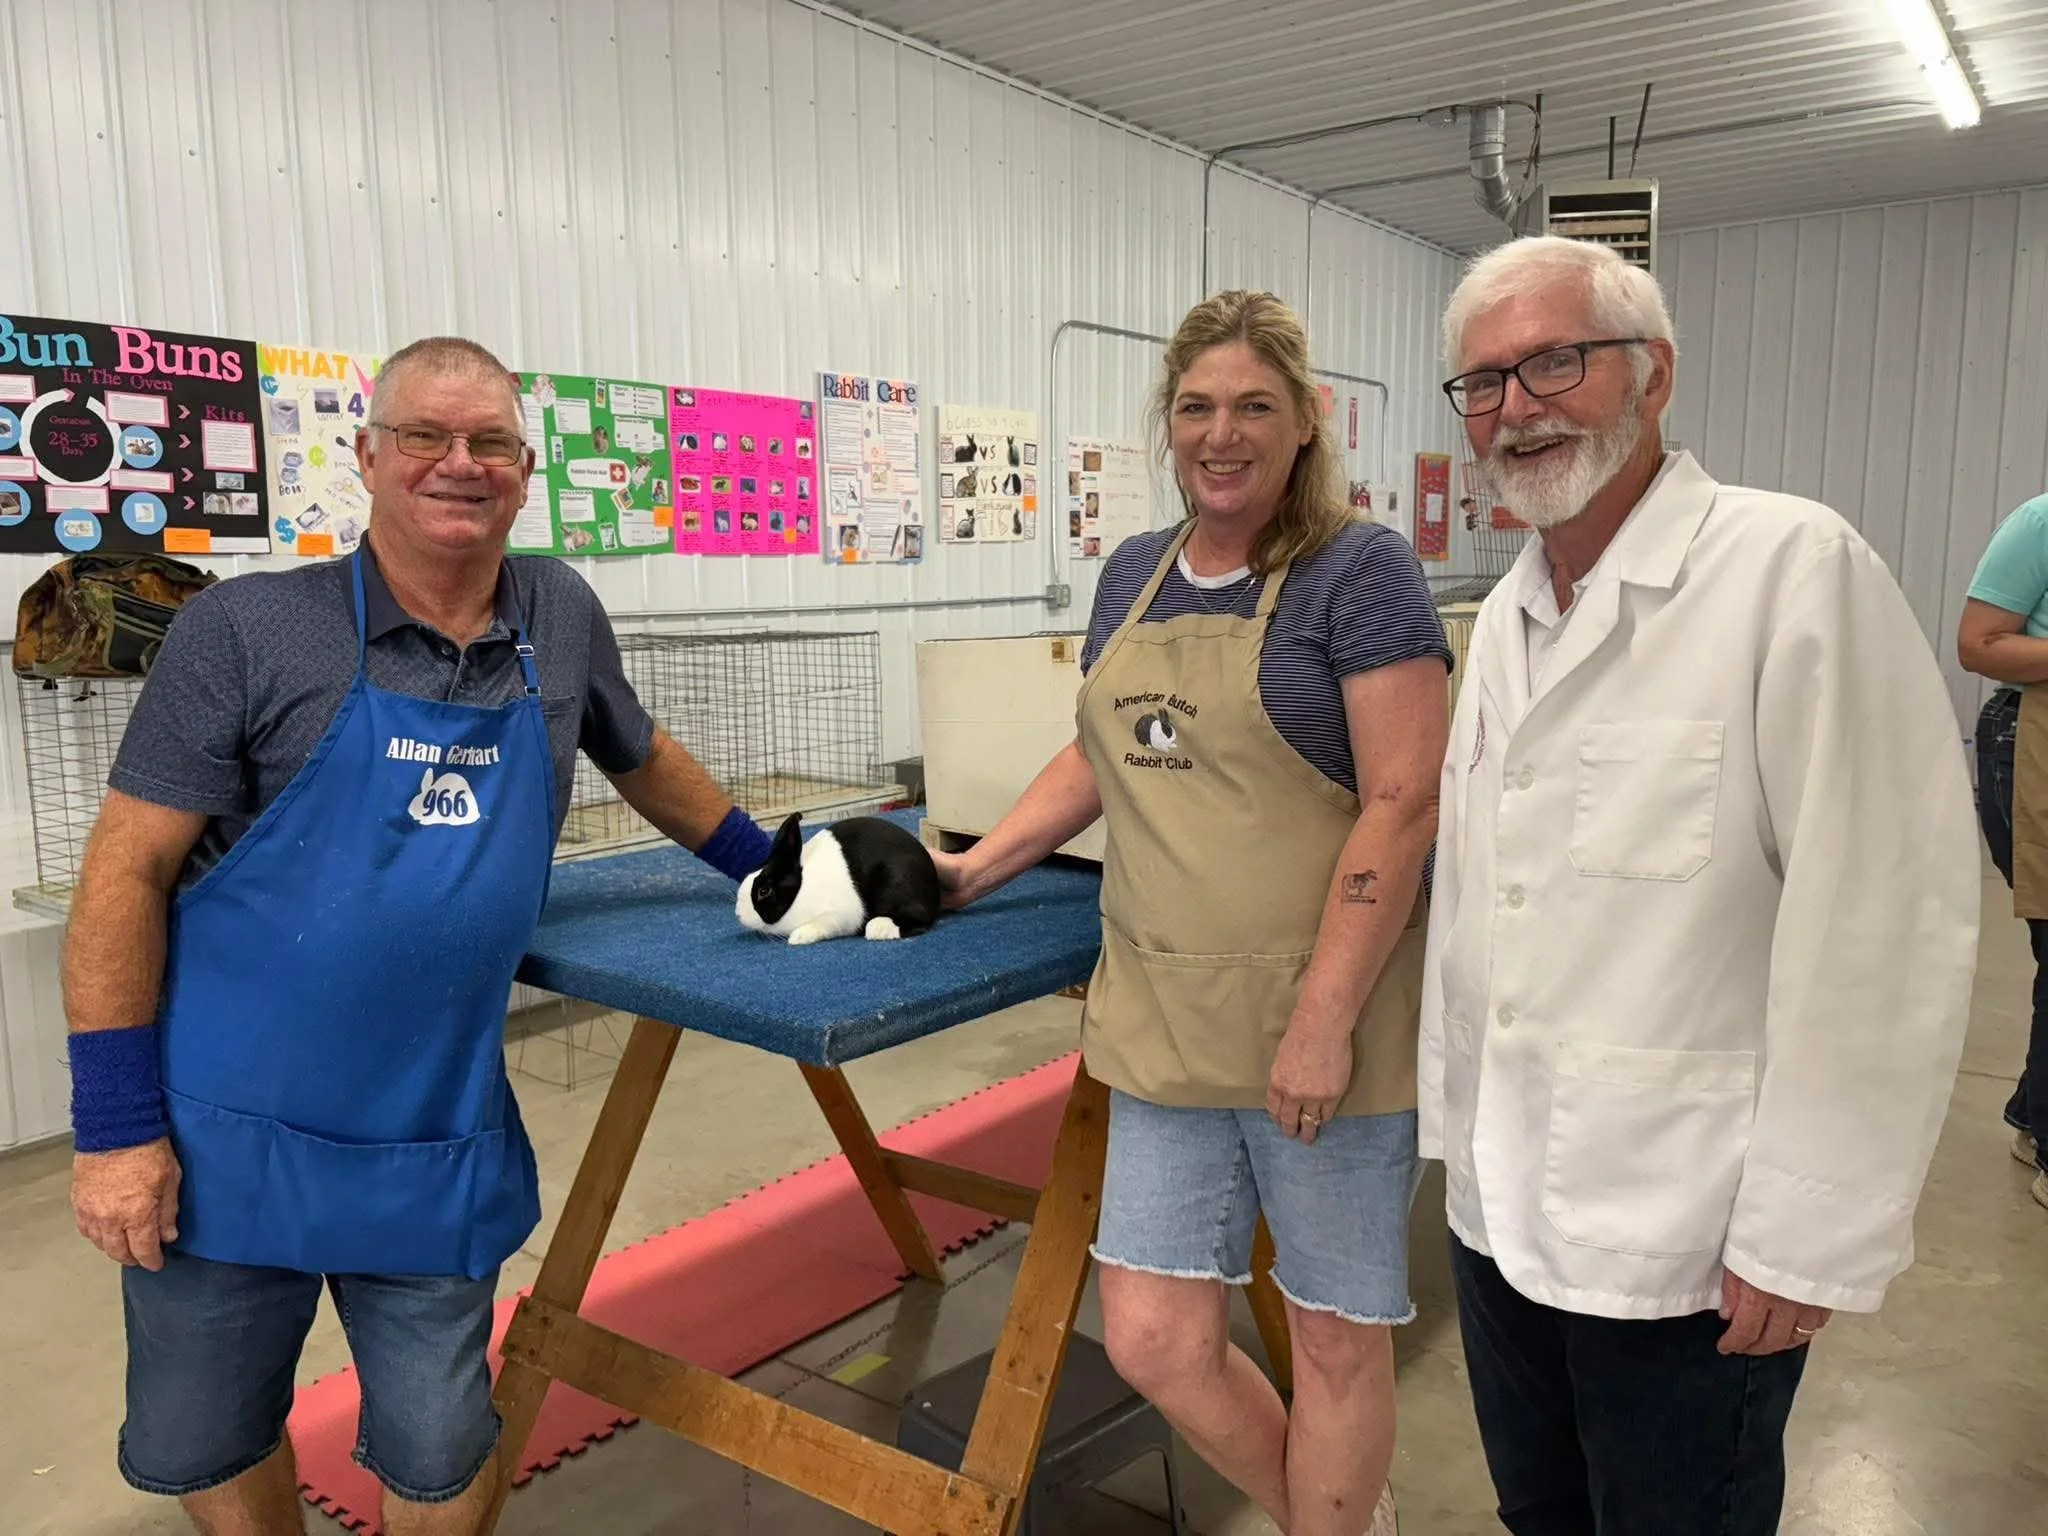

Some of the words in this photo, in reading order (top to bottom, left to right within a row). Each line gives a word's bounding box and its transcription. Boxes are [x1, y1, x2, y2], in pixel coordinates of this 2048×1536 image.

[111, 326, 243, 383] Buns
[262, 346, 349, 380] WHAT
[61, 367, 82, 384] In
[88, 368, 121, 385] The
[130, 375, 174, 391] Oven
[823, 374, 870, 400] Rabbit
[877, 381, 916, 403] Care
[205, 405, 245, 422] Kits
[347, 392, 365, 418] 4
[48, 431, 98, 448] 28-35
[1114, 691, 1166, 712] American
[1167, 694, 1198, 719] Dutch
[386, 737, 442, 764] Allan
[1124, 752, 1162, 769] Rabbit
[1165, 757, 1193, 770] Club
[422, 788, 469, 818] 966
